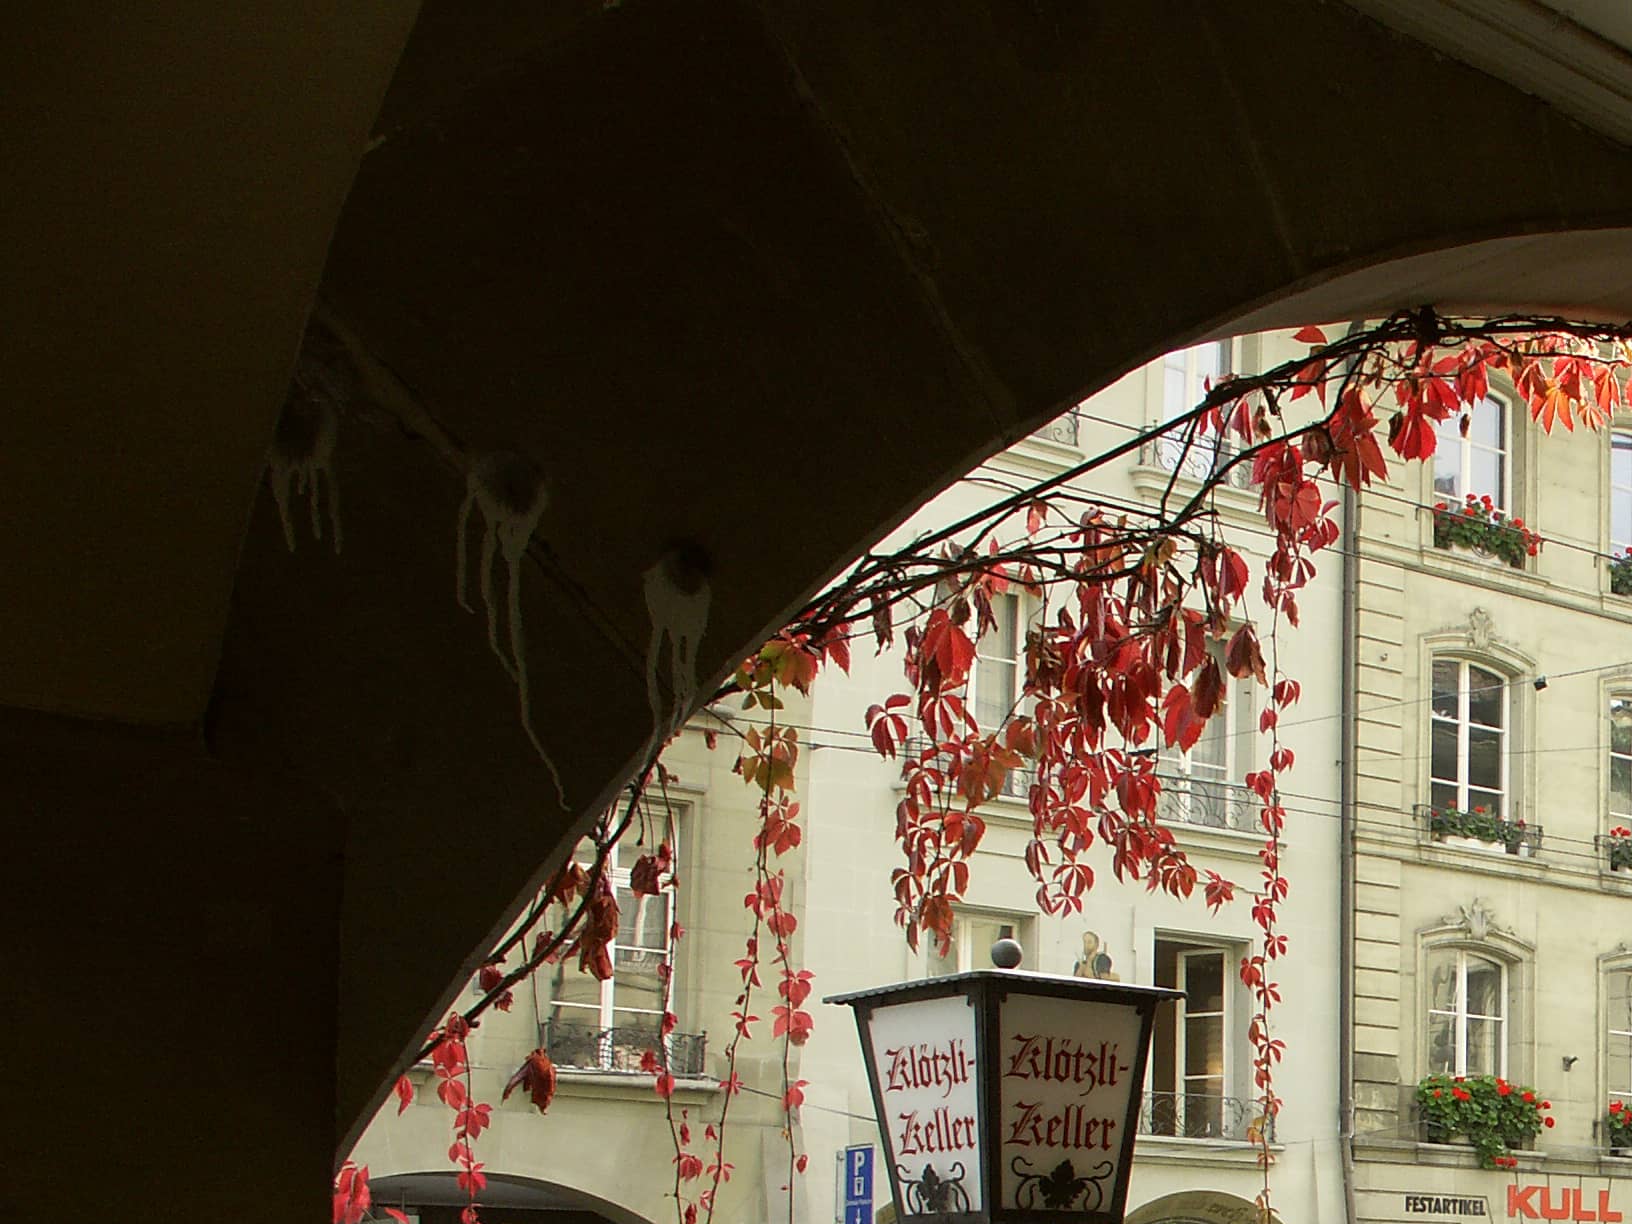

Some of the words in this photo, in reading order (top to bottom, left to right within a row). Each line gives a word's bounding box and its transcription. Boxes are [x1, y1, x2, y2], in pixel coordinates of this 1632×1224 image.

[884, 1038, 976, 1098] Klötzli-
[1003, 1033, 1129, 1097] Klötzli-
[899, 1105, 976, 1156] Keller
[1004, 1100, 1117, 1151] Keller
[854, 1151, 865, 1177] P
[1405, 1196, 1487, 1217] FESTARTIKEL
[1507, 1184, 1623, 1223] KULL
